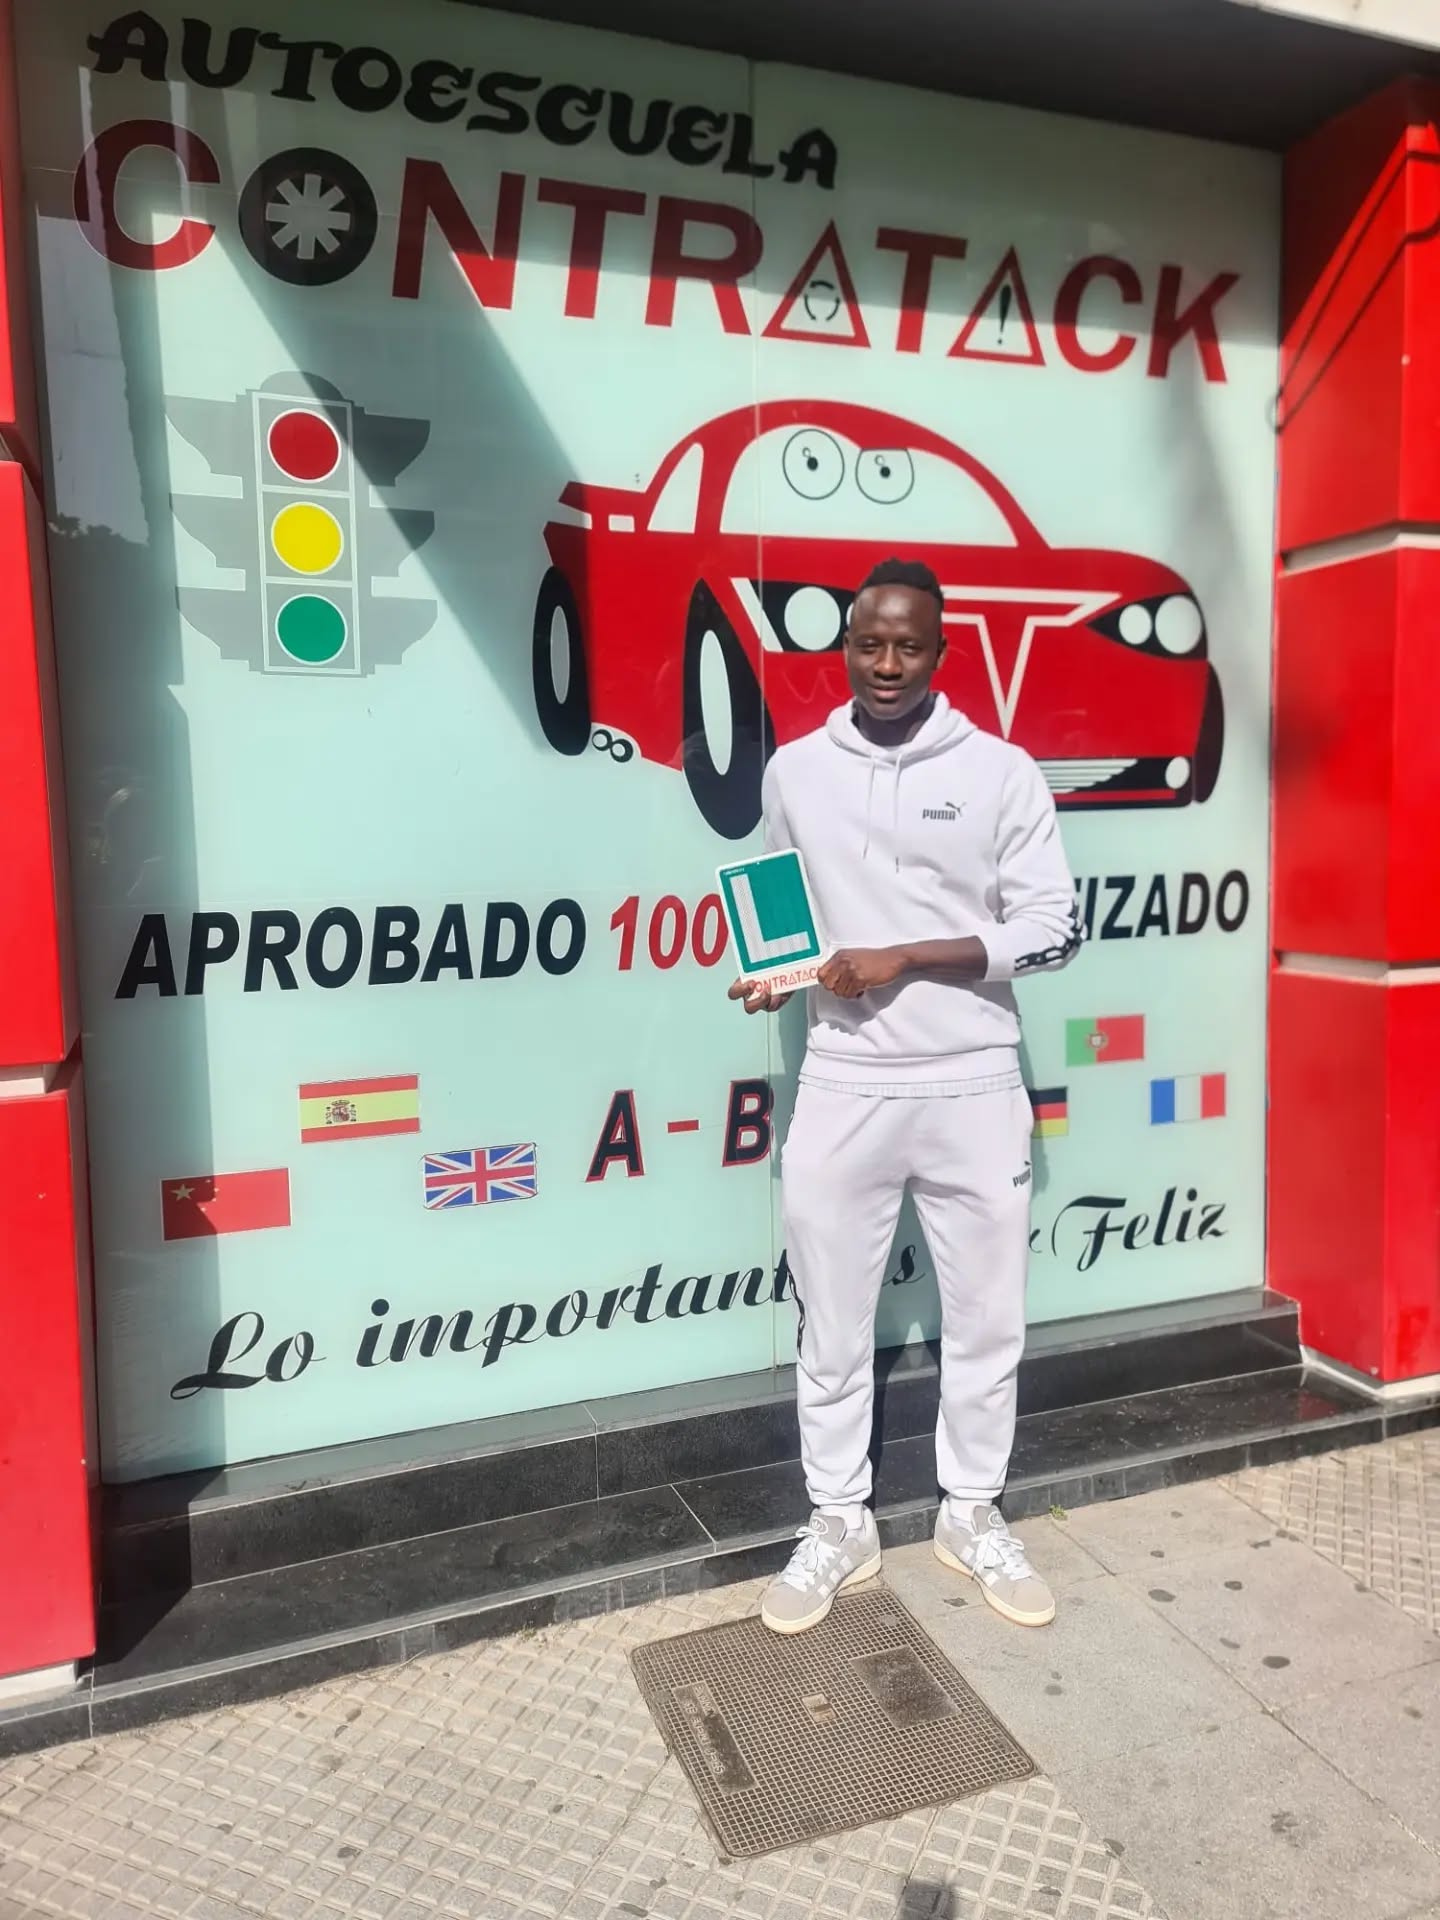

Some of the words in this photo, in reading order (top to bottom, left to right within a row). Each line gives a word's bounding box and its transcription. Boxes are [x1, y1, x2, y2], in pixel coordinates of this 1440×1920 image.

[87, 11, 838, 190] AUTOESCUELA
[73, 118, 1240, 383] CONTRATACK
[922, 808, 956, 821] PUMA
[115, 898, 587, 998] APROBADO
[609, 893, 729, 971] 100
[1074, 869, 1249, 941] IZADO
[729, 874, 812, 963] L
[752, 967, 818, 993] ONTRATAC
[585, 1089, 645, 1183] A
[722, 1078, 775, 1167] B
[170, 1311, 326, 1400] Lo
[355, 1248, 792, 1369] important
[1051, 1186, 1229, 1272] Feliz
